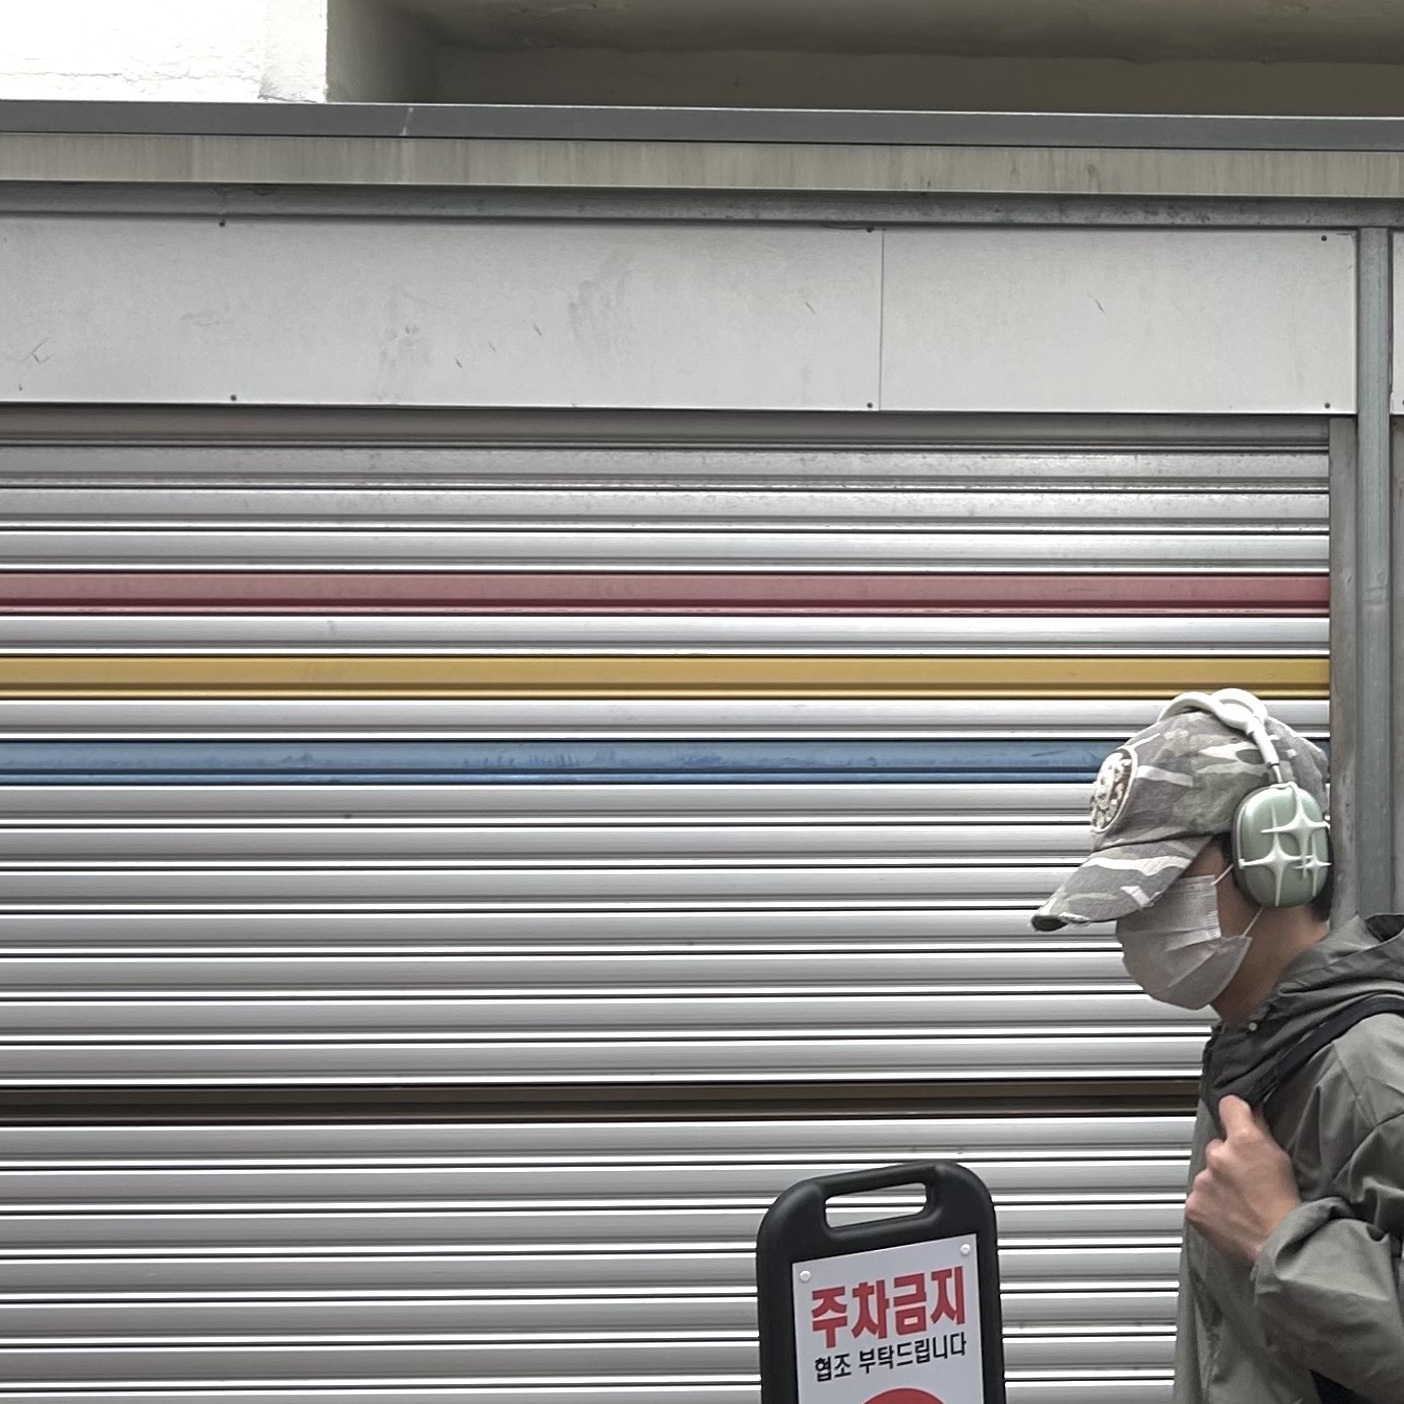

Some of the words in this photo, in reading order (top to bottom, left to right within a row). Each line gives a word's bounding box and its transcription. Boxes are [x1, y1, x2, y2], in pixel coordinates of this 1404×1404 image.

[811, 1265, 966, 1349] 주차금지
[815, 1353, 852, 1382] 협조
[859, 1331, 967, 1374] 부탁드립니다
